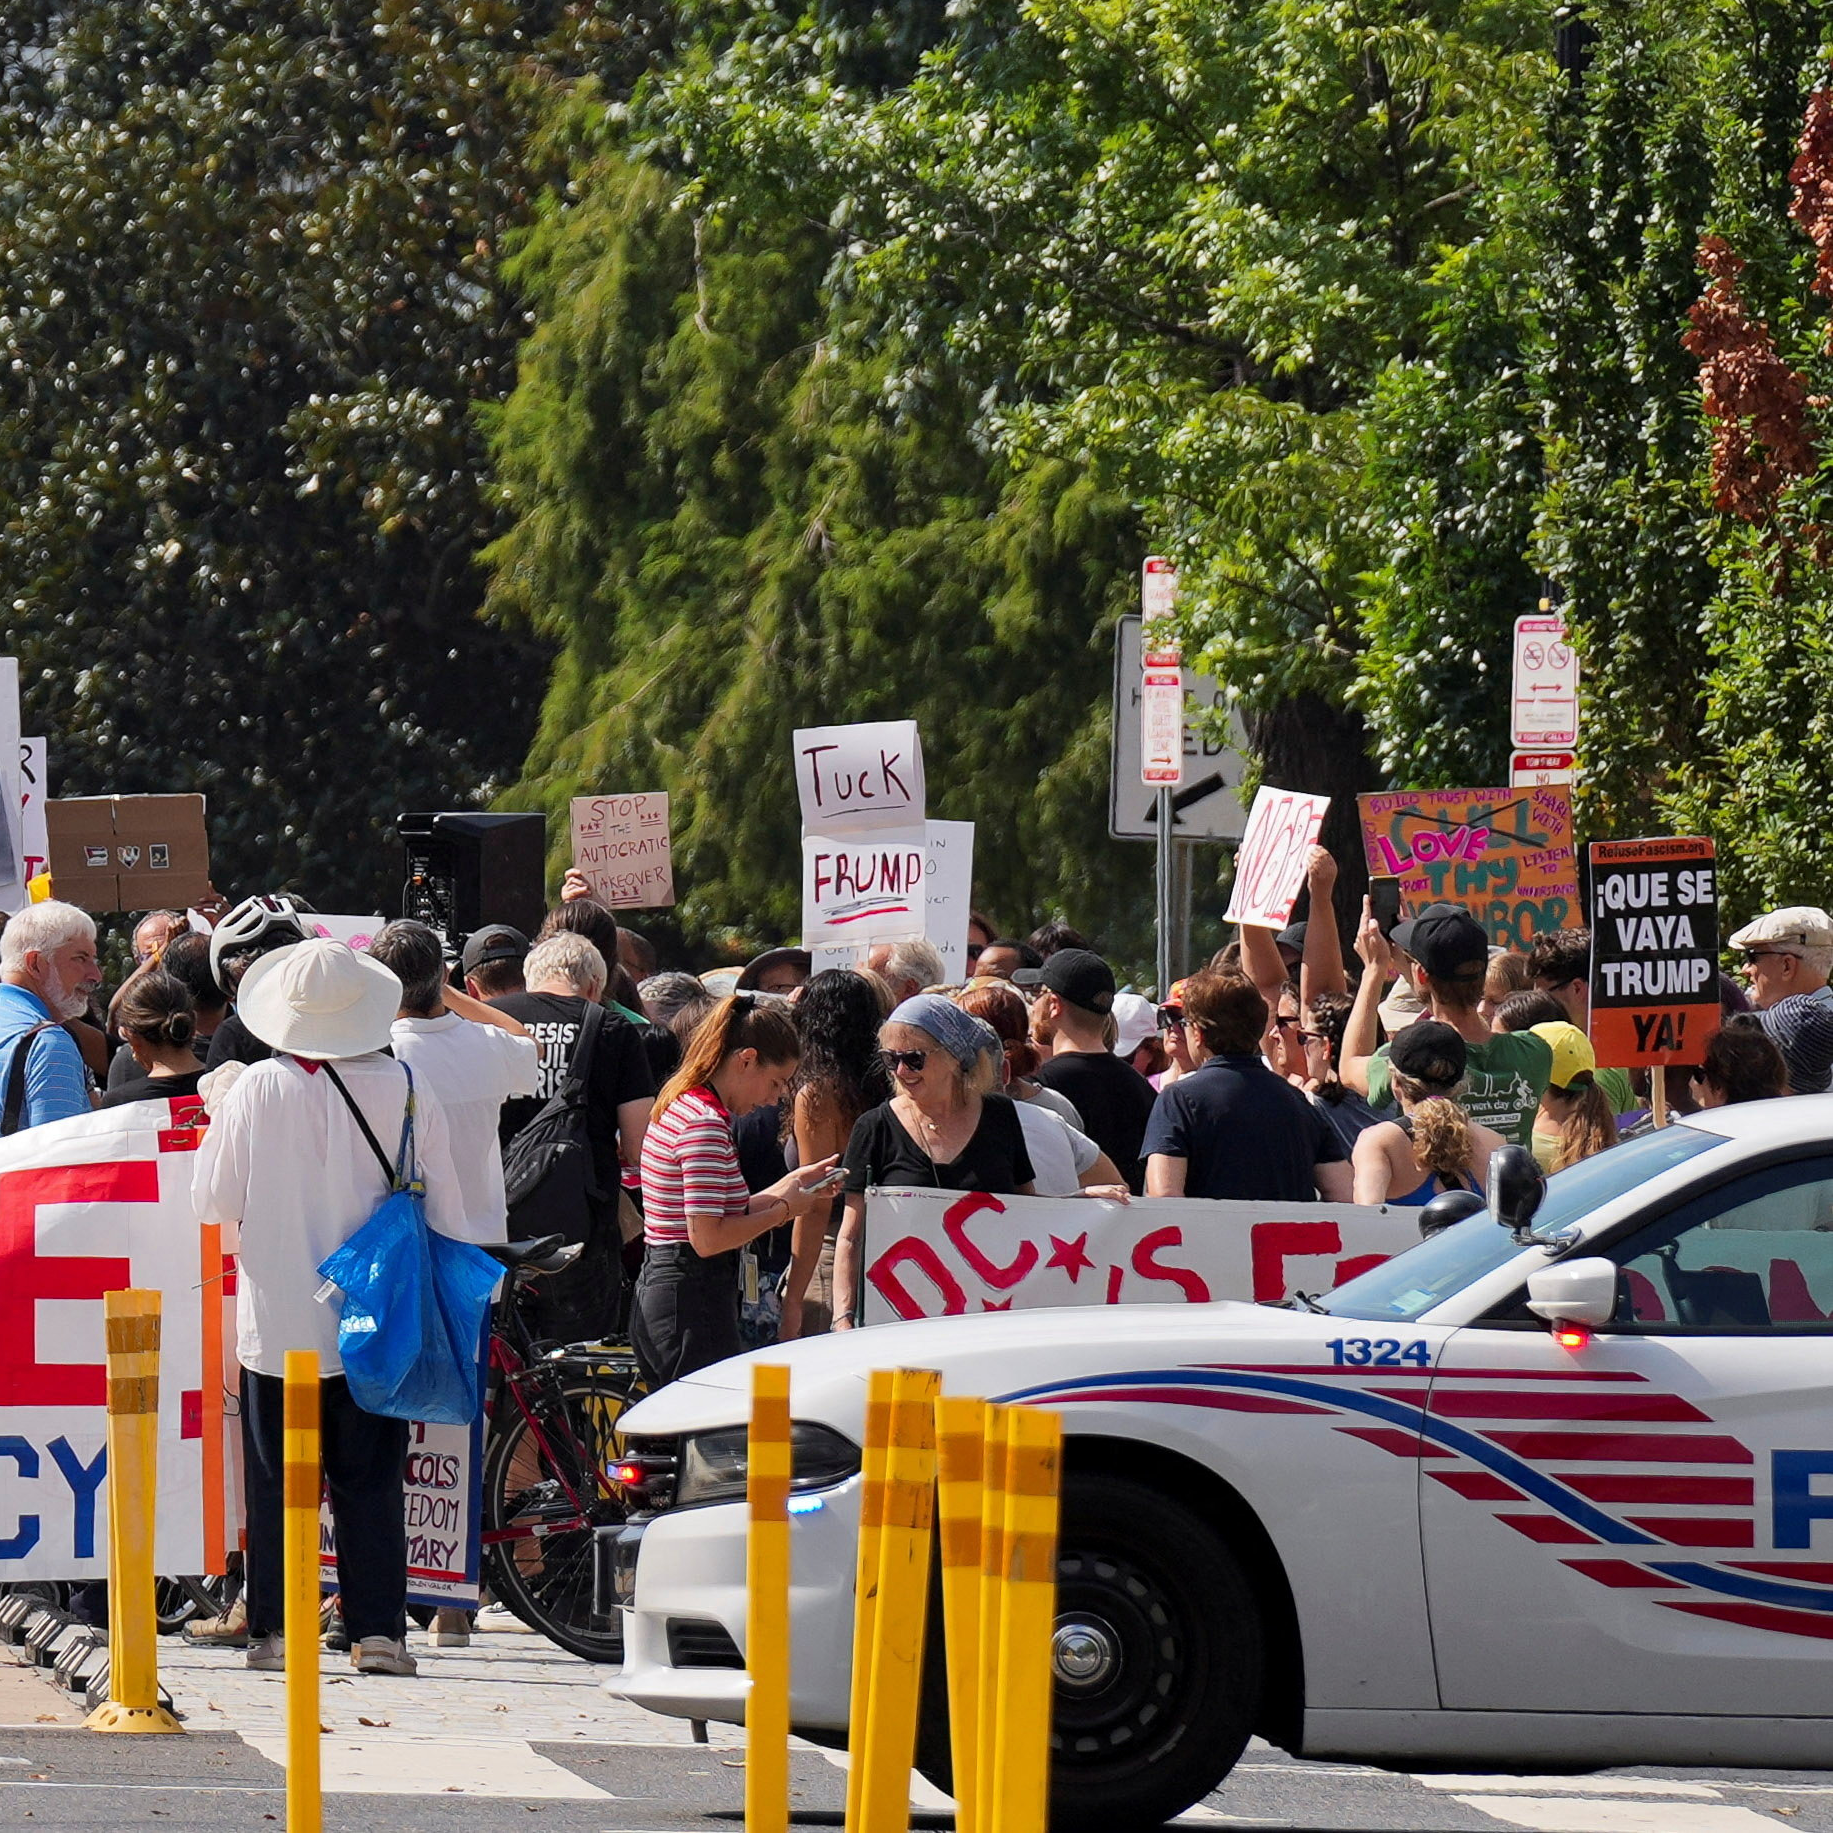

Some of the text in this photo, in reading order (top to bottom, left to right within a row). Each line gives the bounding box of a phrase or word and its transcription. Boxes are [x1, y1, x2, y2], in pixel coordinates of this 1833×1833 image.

[591, 795, 647, 822] STOP
[1370, 793, 1420, 814] BUILD
[1473, 788, 1512, 803] WITH
[610, 822, 631, 836] THE
[580, 836, 668, 863] AUTOCRATIC
[1377, 824, 1491, 876] LOVE
[1598, 842, 1705, 859] RefuseFascism.org
[588, 866, 667, 892] TAKEOVER
[814, 852, 922, 904] FRUMP
[1424, 856, 1521, 898] THY
[1596, 870, 1714, 918] ¡QUE SE
[1615, 915, 1695, 952] VAYA
[1600, 958, 1711, 997] TRUMP
[1632, 1012, 1686, 1052] YA!
[1325, 1337, 1432, 1367] 1324
